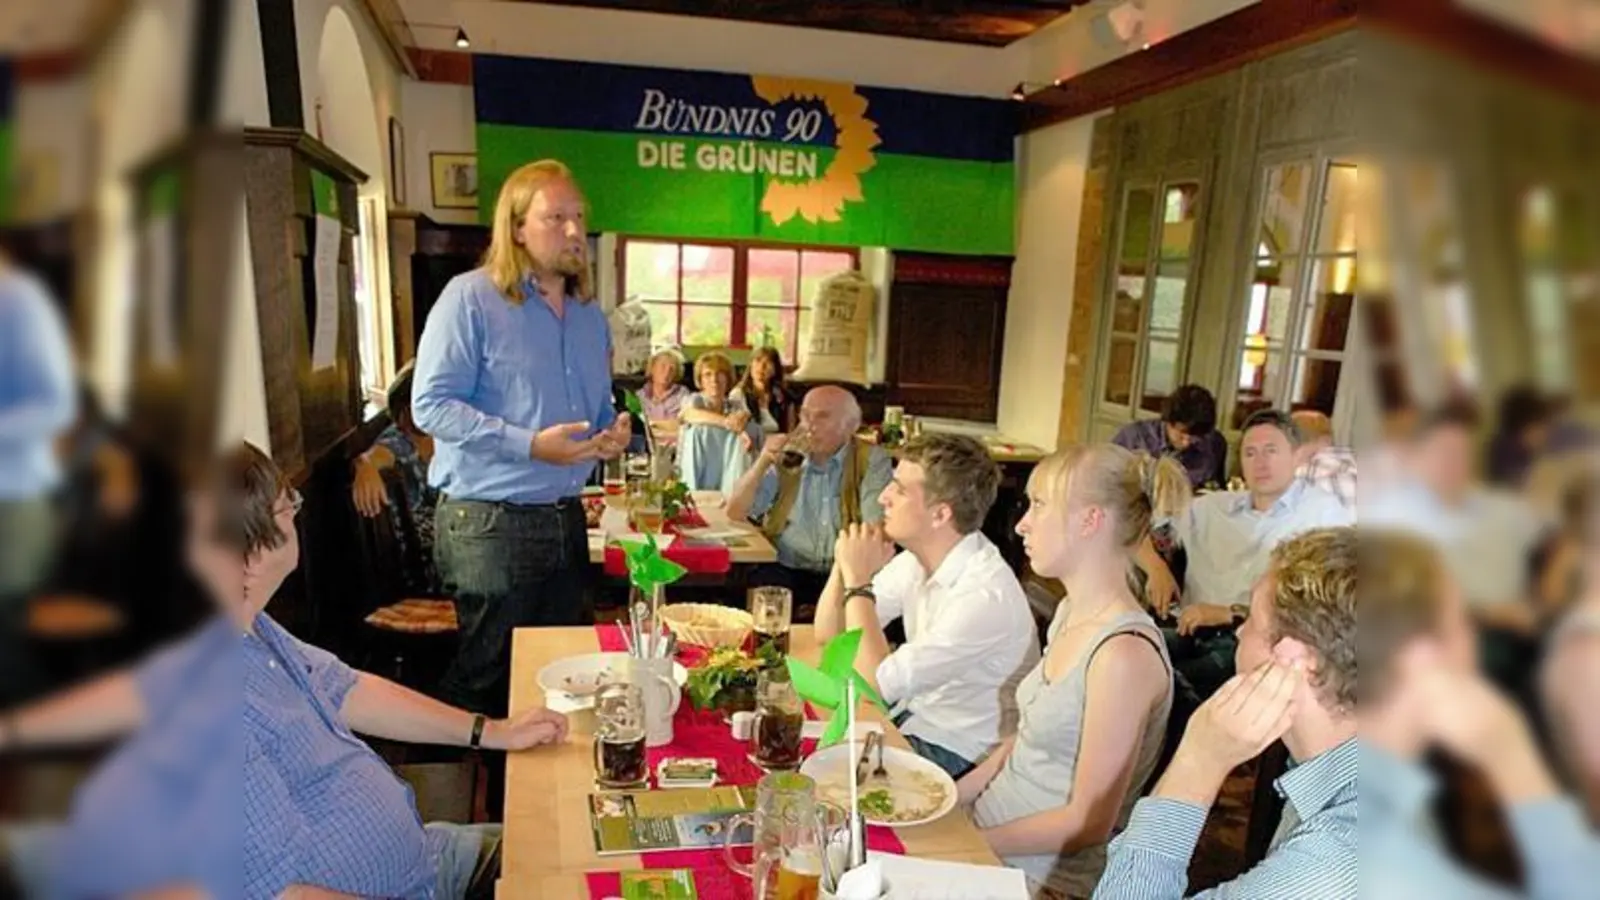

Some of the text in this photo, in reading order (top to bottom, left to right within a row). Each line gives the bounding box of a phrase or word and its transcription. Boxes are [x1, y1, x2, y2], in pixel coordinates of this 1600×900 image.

[636, 89, 821, 142] BÜNDNIS 90
[637, 141, 817, 177] DIE GRÜNEN
